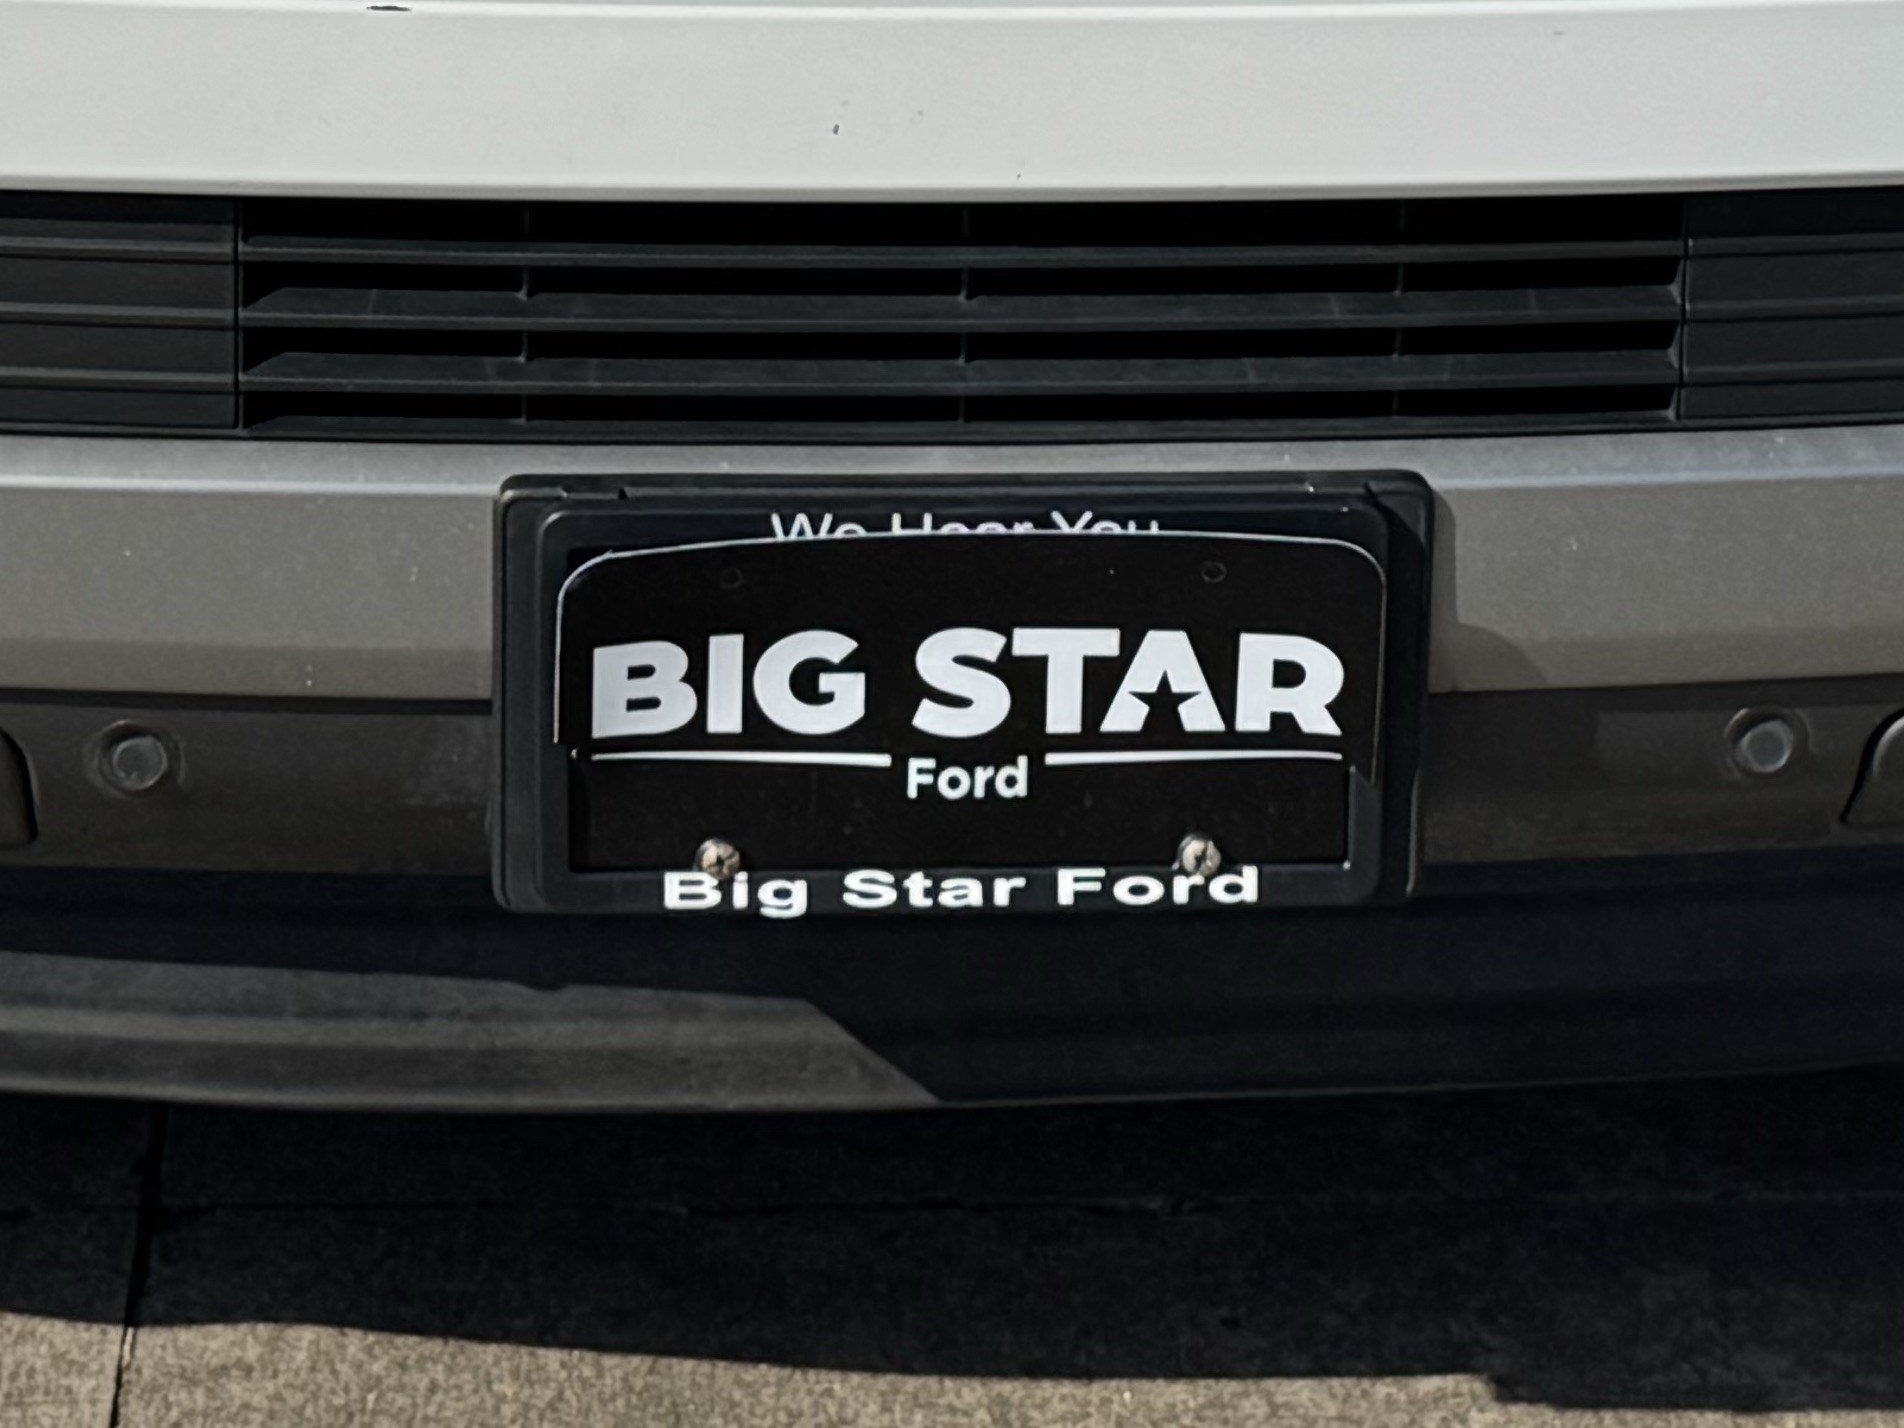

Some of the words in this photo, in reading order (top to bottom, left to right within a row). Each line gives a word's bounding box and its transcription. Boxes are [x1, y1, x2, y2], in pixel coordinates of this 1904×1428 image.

[592, 628, 866, 739] BIG
[912, 627, 1345, 738] STAR
[906, 756, 1029, 800] Ford
[663, 867, 809, 919] Big
[842, 869, 1028, 910] Star
[1057, 861, 1260, 907] Ford
